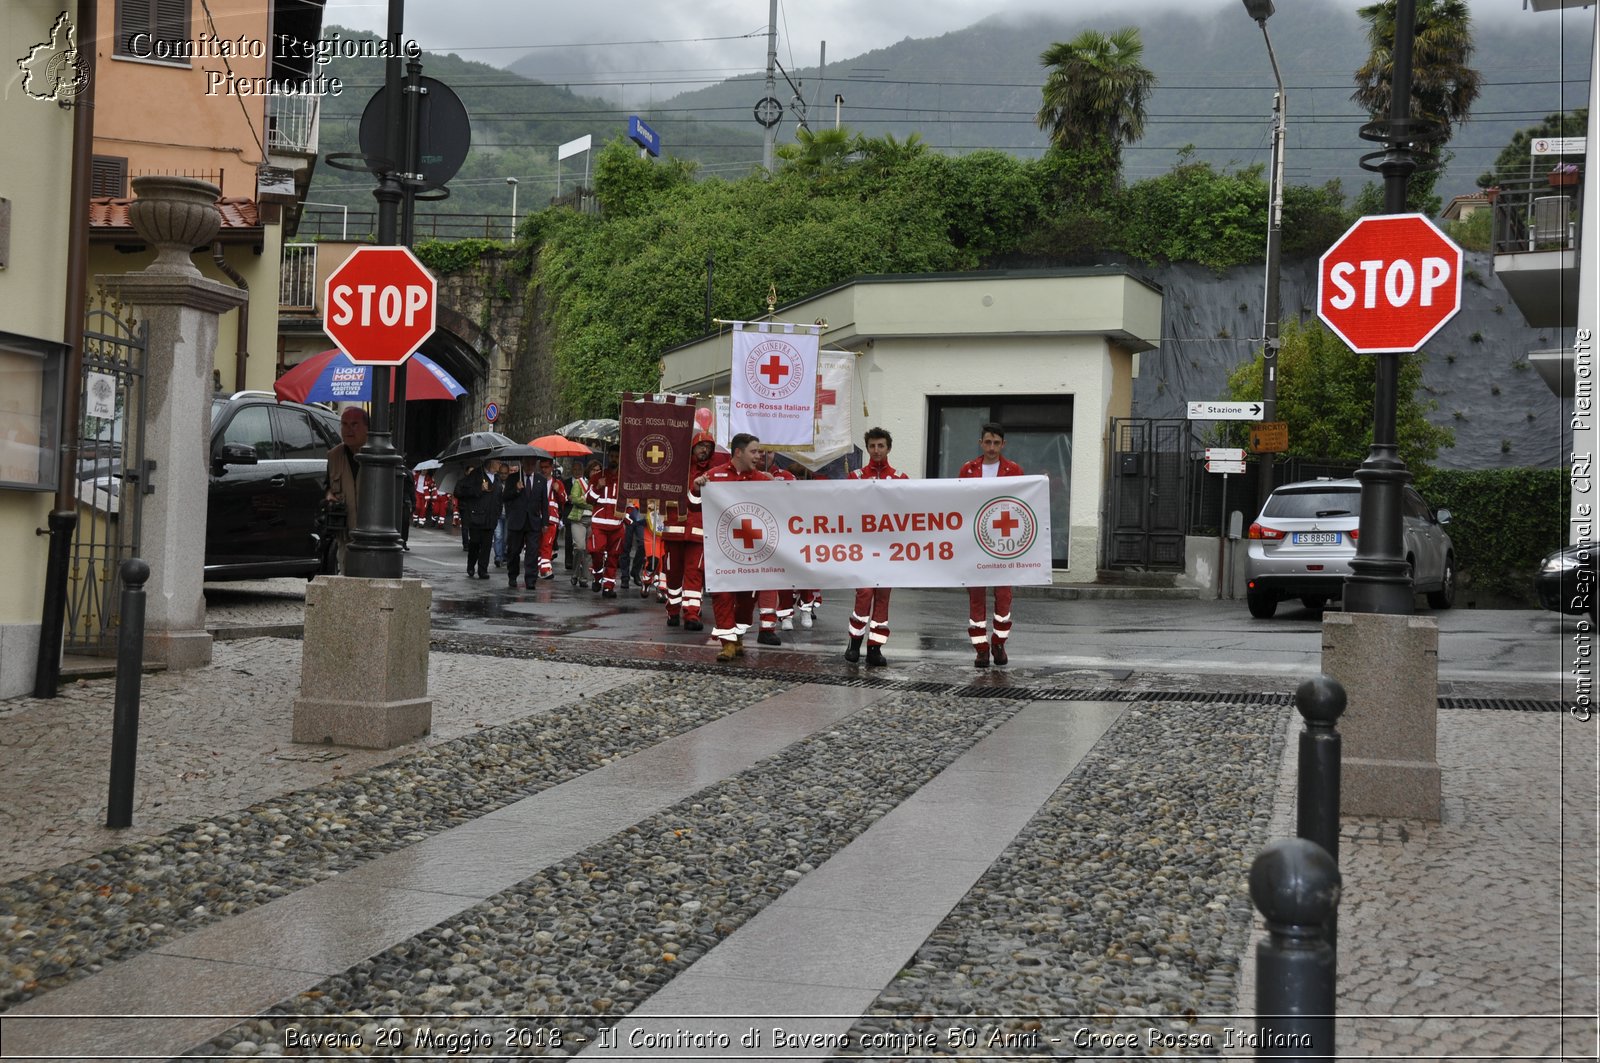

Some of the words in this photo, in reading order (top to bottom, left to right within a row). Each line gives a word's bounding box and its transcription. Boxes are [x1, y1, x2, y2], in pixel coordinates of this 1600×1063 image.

[1329, 257, 1451, 310] STOP
[332, 284, 429, 328] STOP
[754, 348, 763, 358] DI
[789, 363, 802, 389] AGOSTO
[735, 401, 757, 409] Croce
[759, 403, 782, 411] Rossa
[784, 404, 811, 412] Italiana
[1208, 406, 1242, 414] Stazione
[624, 417, 643, 426] CROCE
[646, 418, 665, 426] ROSSA
[667, 419, 689, 428] ITALIANA
[1250, 424, 1287, 432] MERCATO
[623, 482, 653, 491] DELEGAZIONE
[787, 514, 853, 535] C.R.I.
[861, 511, 963, 533] BAVENO
[1299, 534, 1308, 542] ES
[1310, 533, 1336, 542] 885DB
[997, 538, 1015, 552] 50
[799, 543, 864, 563] 1968
[889, 541, 954, 562] 2018
